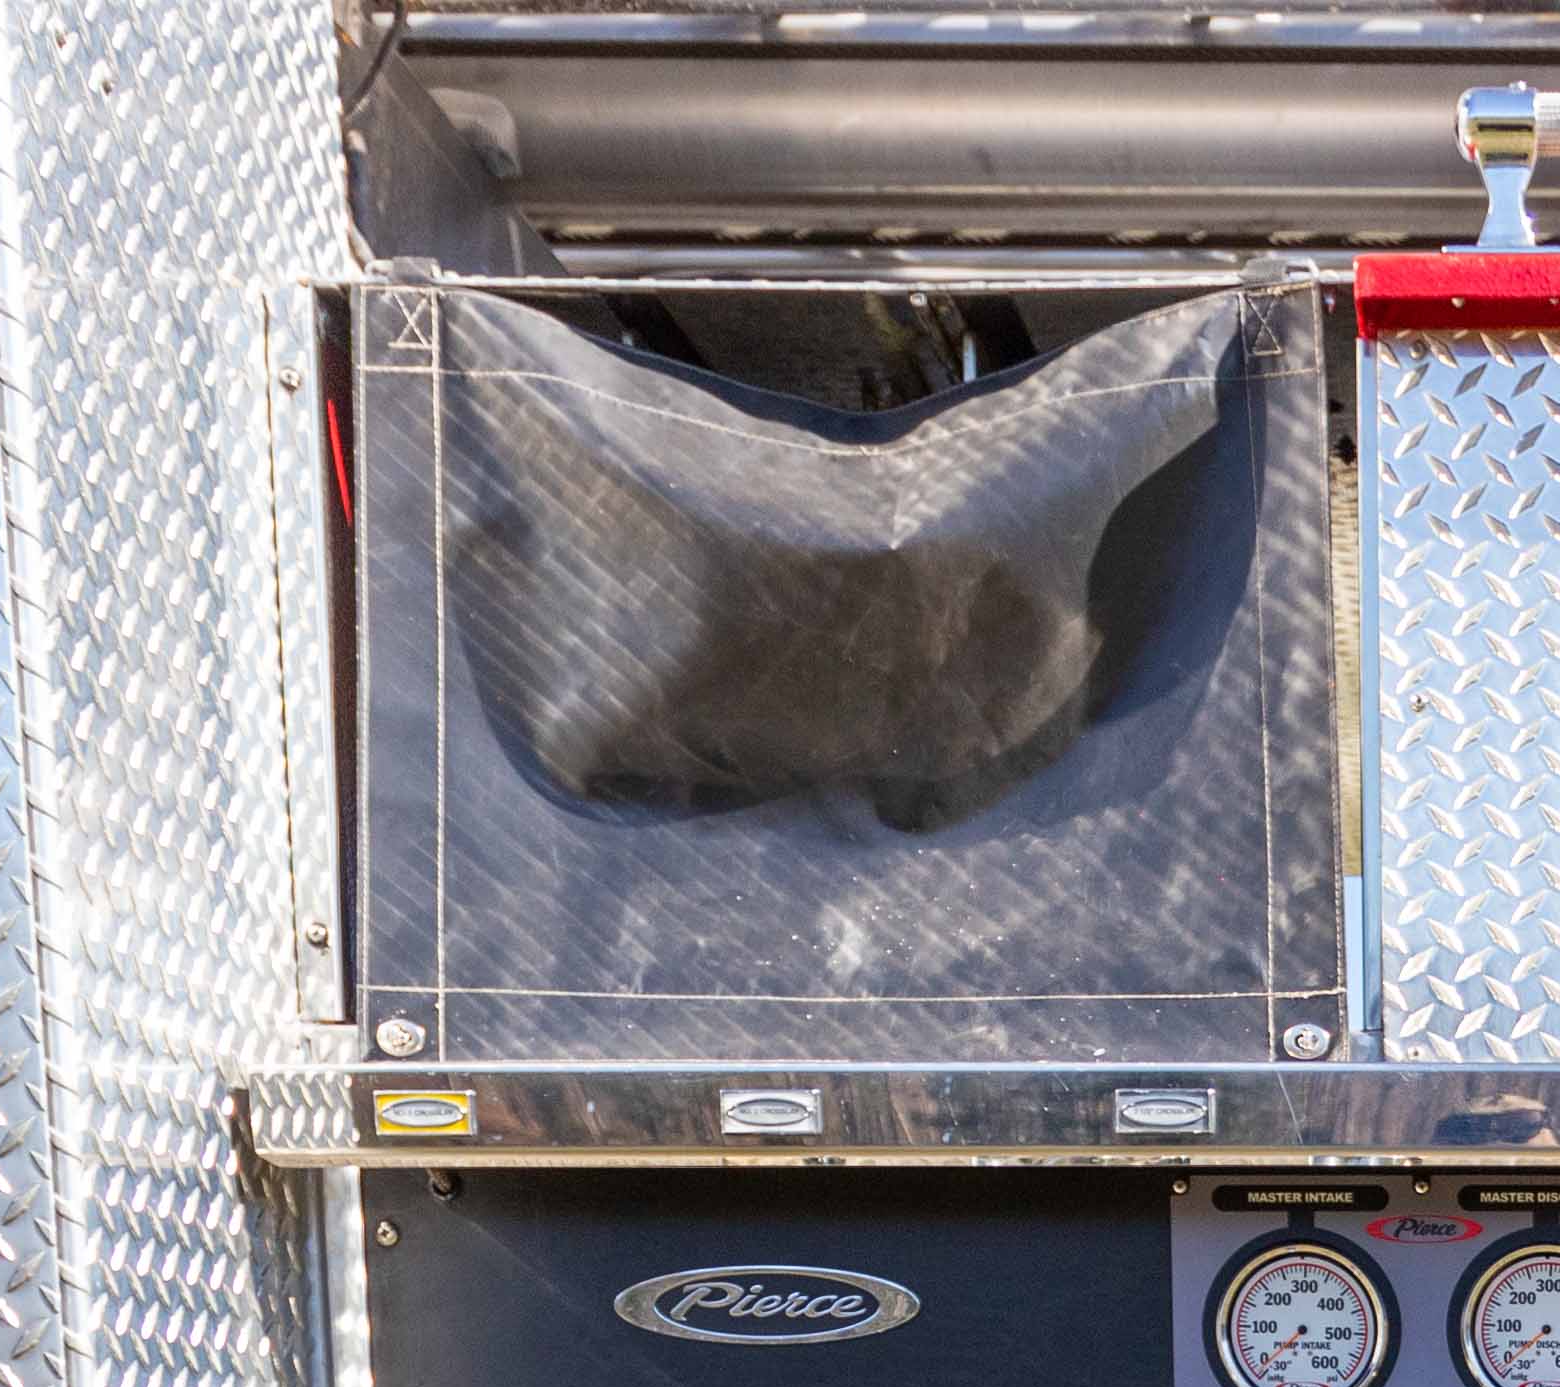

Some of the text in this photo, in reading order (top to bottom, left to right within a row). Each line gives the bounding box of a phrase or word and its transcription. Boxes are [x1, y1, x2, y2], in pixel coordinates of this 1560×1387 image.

[1248, 1192, 1353, 1203] MASTER INTAKE
[1480, 1192, 1534, 1203] MASTER
[1393, 1218, 1457, 1237] Pierce
[1291, 1280, 1318, 1293] 300
[670, 1281, 868, 1321] Pierce
[1265, 1292, 1291, 1306] 200
[1317, 1298, 1344, 1311] 400
[1509, 1292, 1536, 1305] 200
[1252, 1321, 1277, 1334] 100
[1497, 1319, 1521, 1332] 100
[1325, 1327, 1352, 1340] 500
[1301, 1342, 1332, 1350] INTAKE
[1311, 1356, 1338, 1369] 600
[1504, 1351, 1512, 1364] 0
